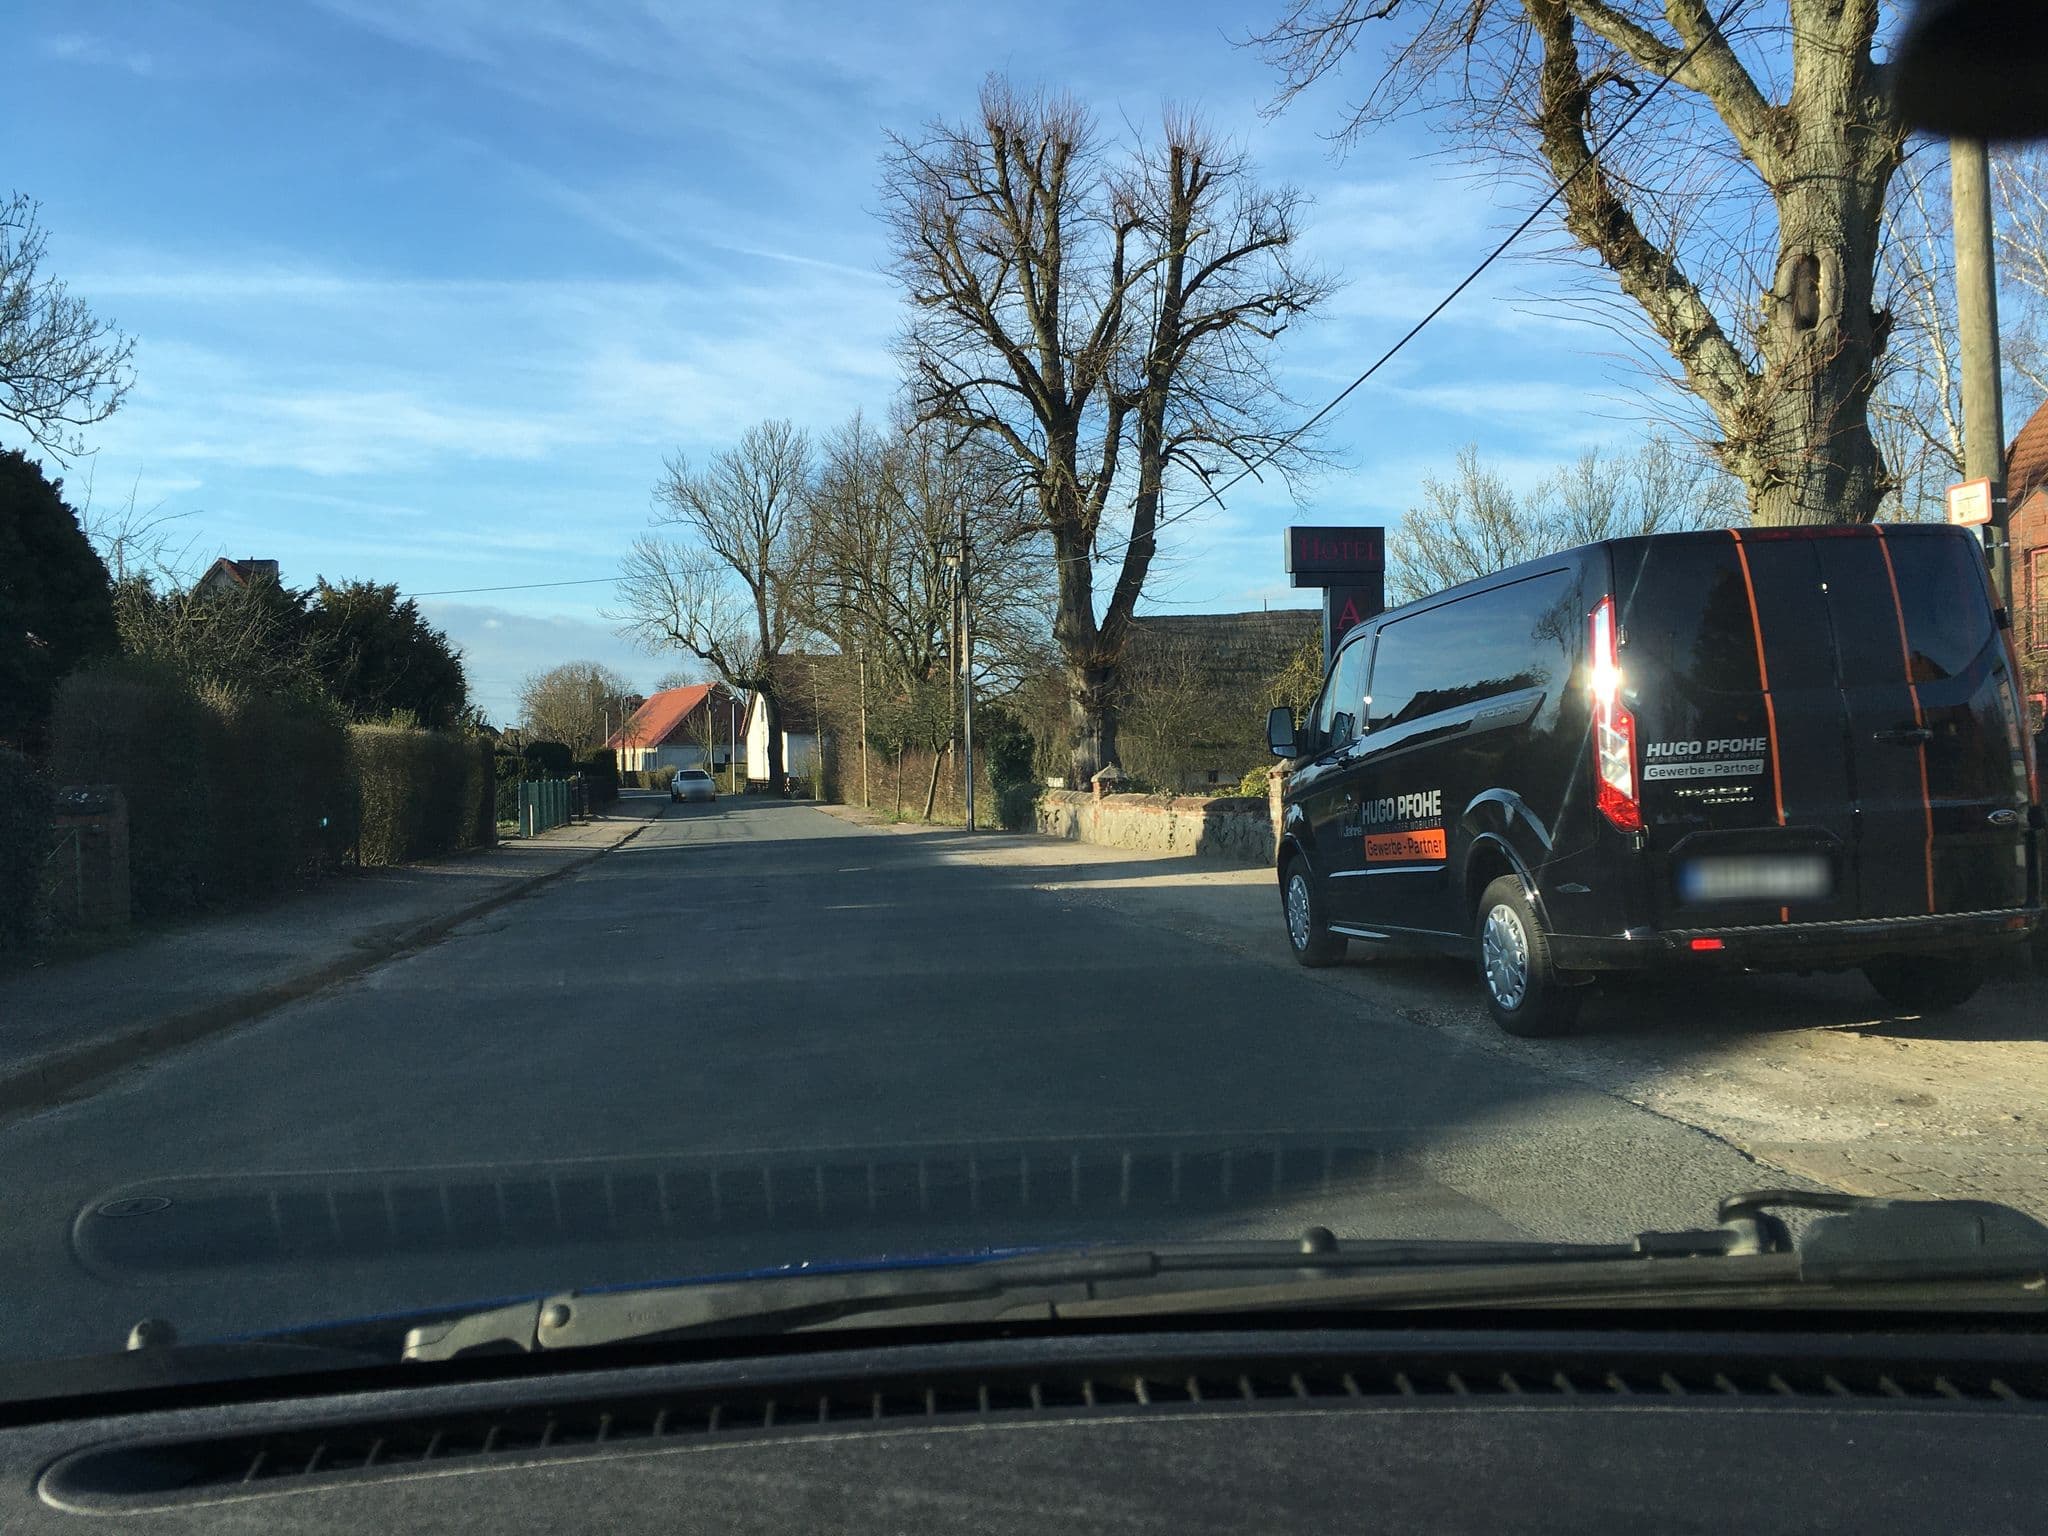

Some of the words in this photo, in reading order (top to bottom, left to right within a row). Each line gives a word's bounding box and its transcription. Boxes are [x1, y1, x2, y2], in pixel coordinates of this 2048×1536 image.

[1300, 537, 1381, 561] HOTEL
[1646, 741, 1702, 757] HUGO
[1706, 737, 1767, 753] PFOHE
[1362, 798, 1395, 824] HUGO
[1397, 790, 1442, 820] PFOHE
